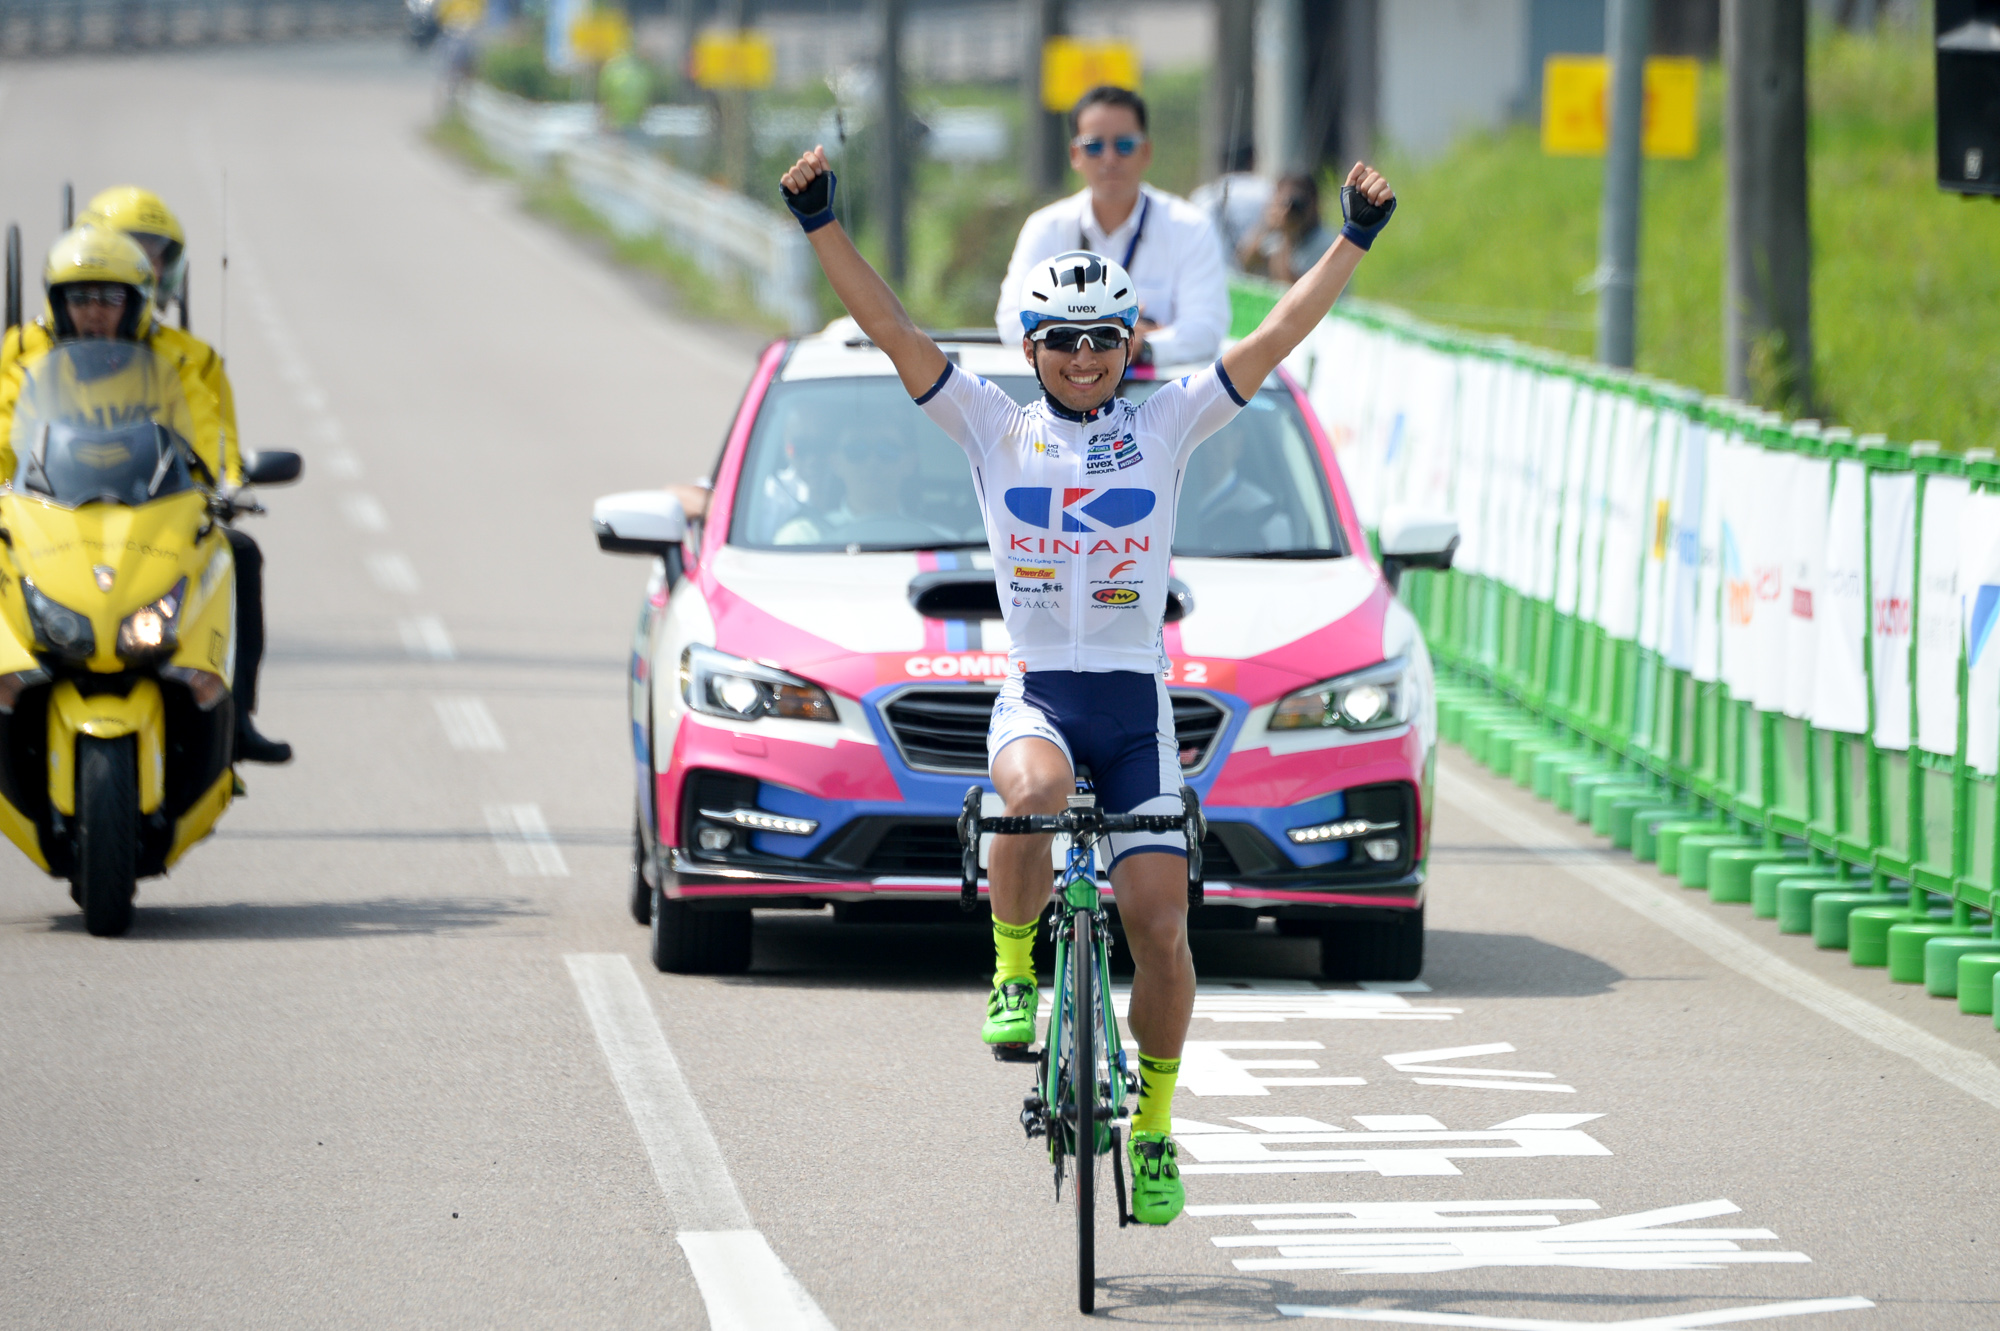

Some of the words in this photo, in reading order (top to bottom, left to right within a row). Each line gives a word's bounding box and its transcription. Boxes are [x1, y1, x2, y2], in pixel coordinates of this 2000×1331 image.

[1067, 304, 1097, 314] uvex
[1086, 460, 1114, 469] uvex
[1010, 533, 1150, 555] KINAN
[1008, 555, 1033, 563] KINAN
[1015, 567, 1054, 578] PowerBar
[1100, 592, 1134, 600] NW
[1023, 600, 1060, 609] AACA
[1183, 662, 1207, 684] 2
